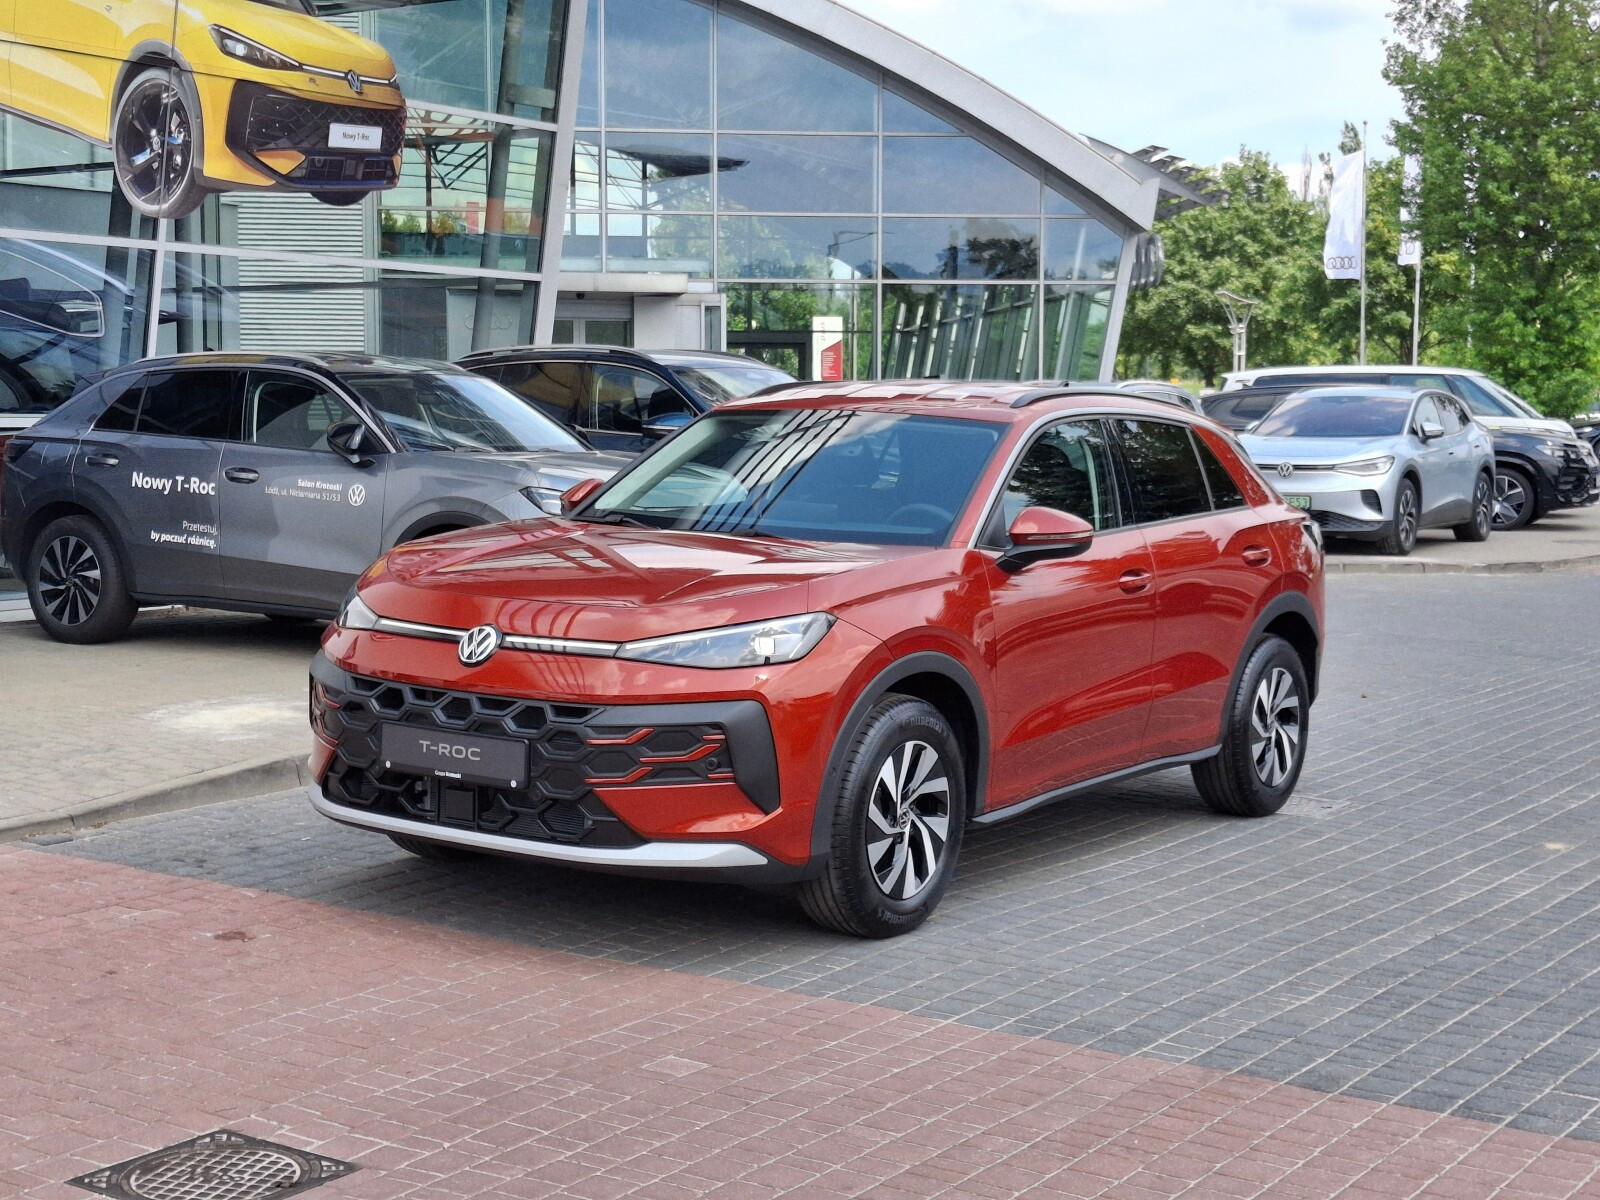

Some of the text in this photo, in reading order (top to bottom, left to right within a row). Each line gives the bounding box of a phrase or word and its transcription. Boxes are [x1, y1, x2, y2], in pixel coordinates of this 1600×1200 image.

[131, 471, 216, 495] Nowy T-Roc
[297, 479, 343, 492] Salon Krotoski
[150, 530, 217, 549] by poczuć różnicę.
[418, 739, 481, 761] T-ROC
